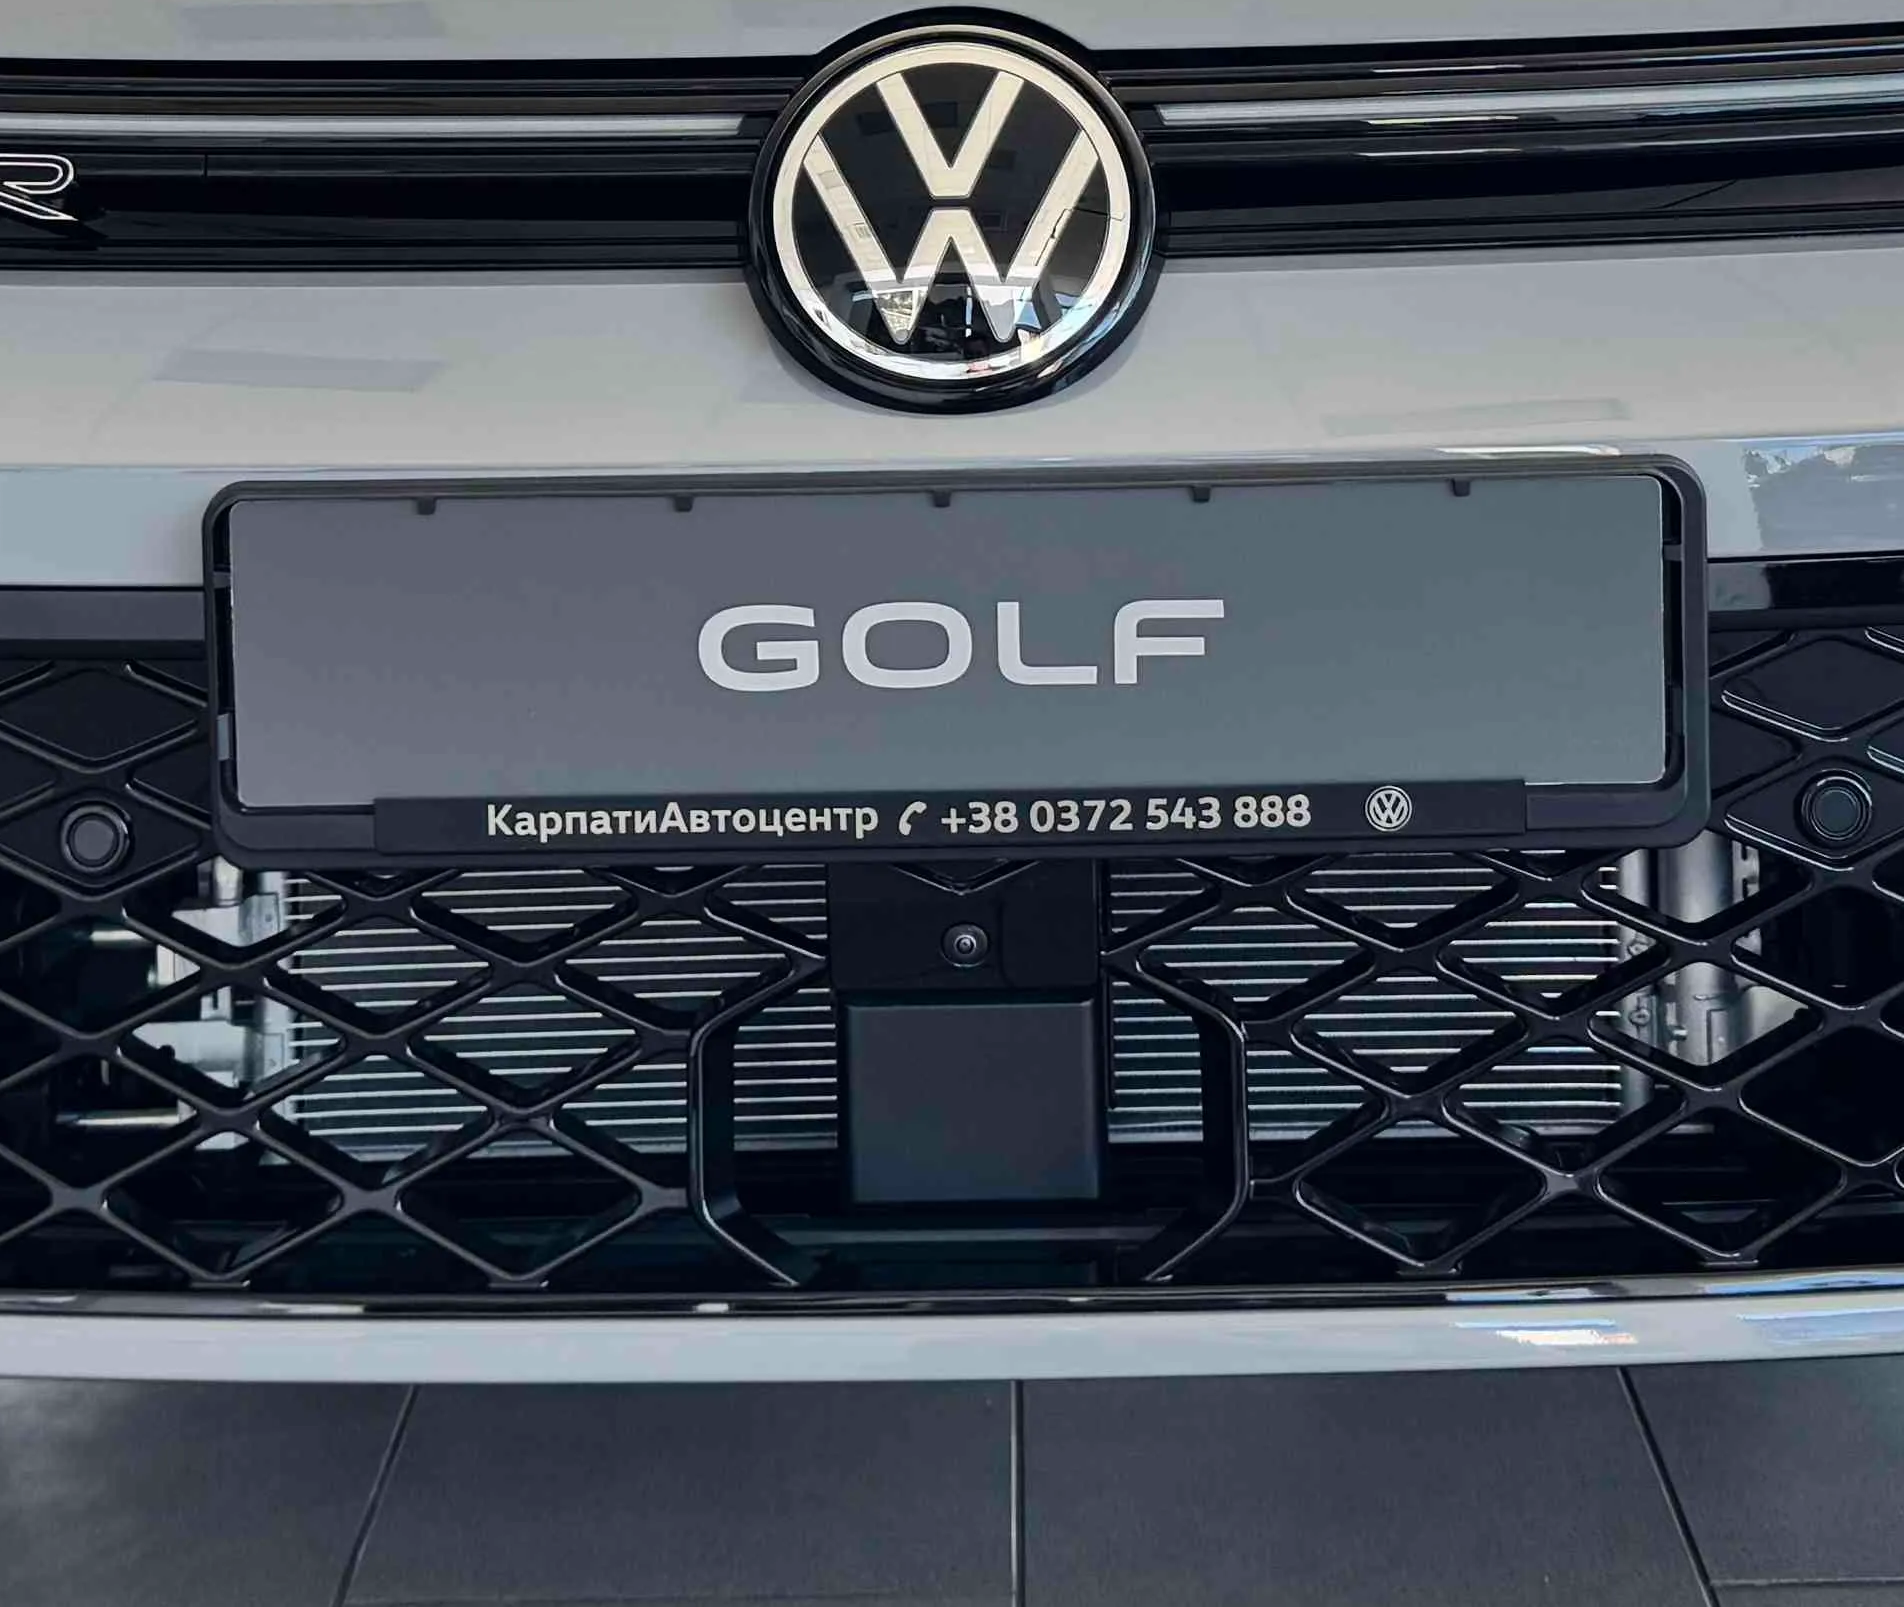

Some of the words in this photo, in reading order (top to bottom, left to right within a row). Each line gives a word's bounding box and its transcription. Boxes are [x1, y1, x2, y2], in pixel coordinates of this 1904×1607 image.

[696, 598, 1225, 692] GOLF
[487, 801, 879, 843] КарпатиАвтоцентр
[941, 801, 1018, 834] +38
[1030, 799, 1133, 832] 0372
[1146, 796, 1222, 830] 543
[1233, 794, 1311, 828] 888
